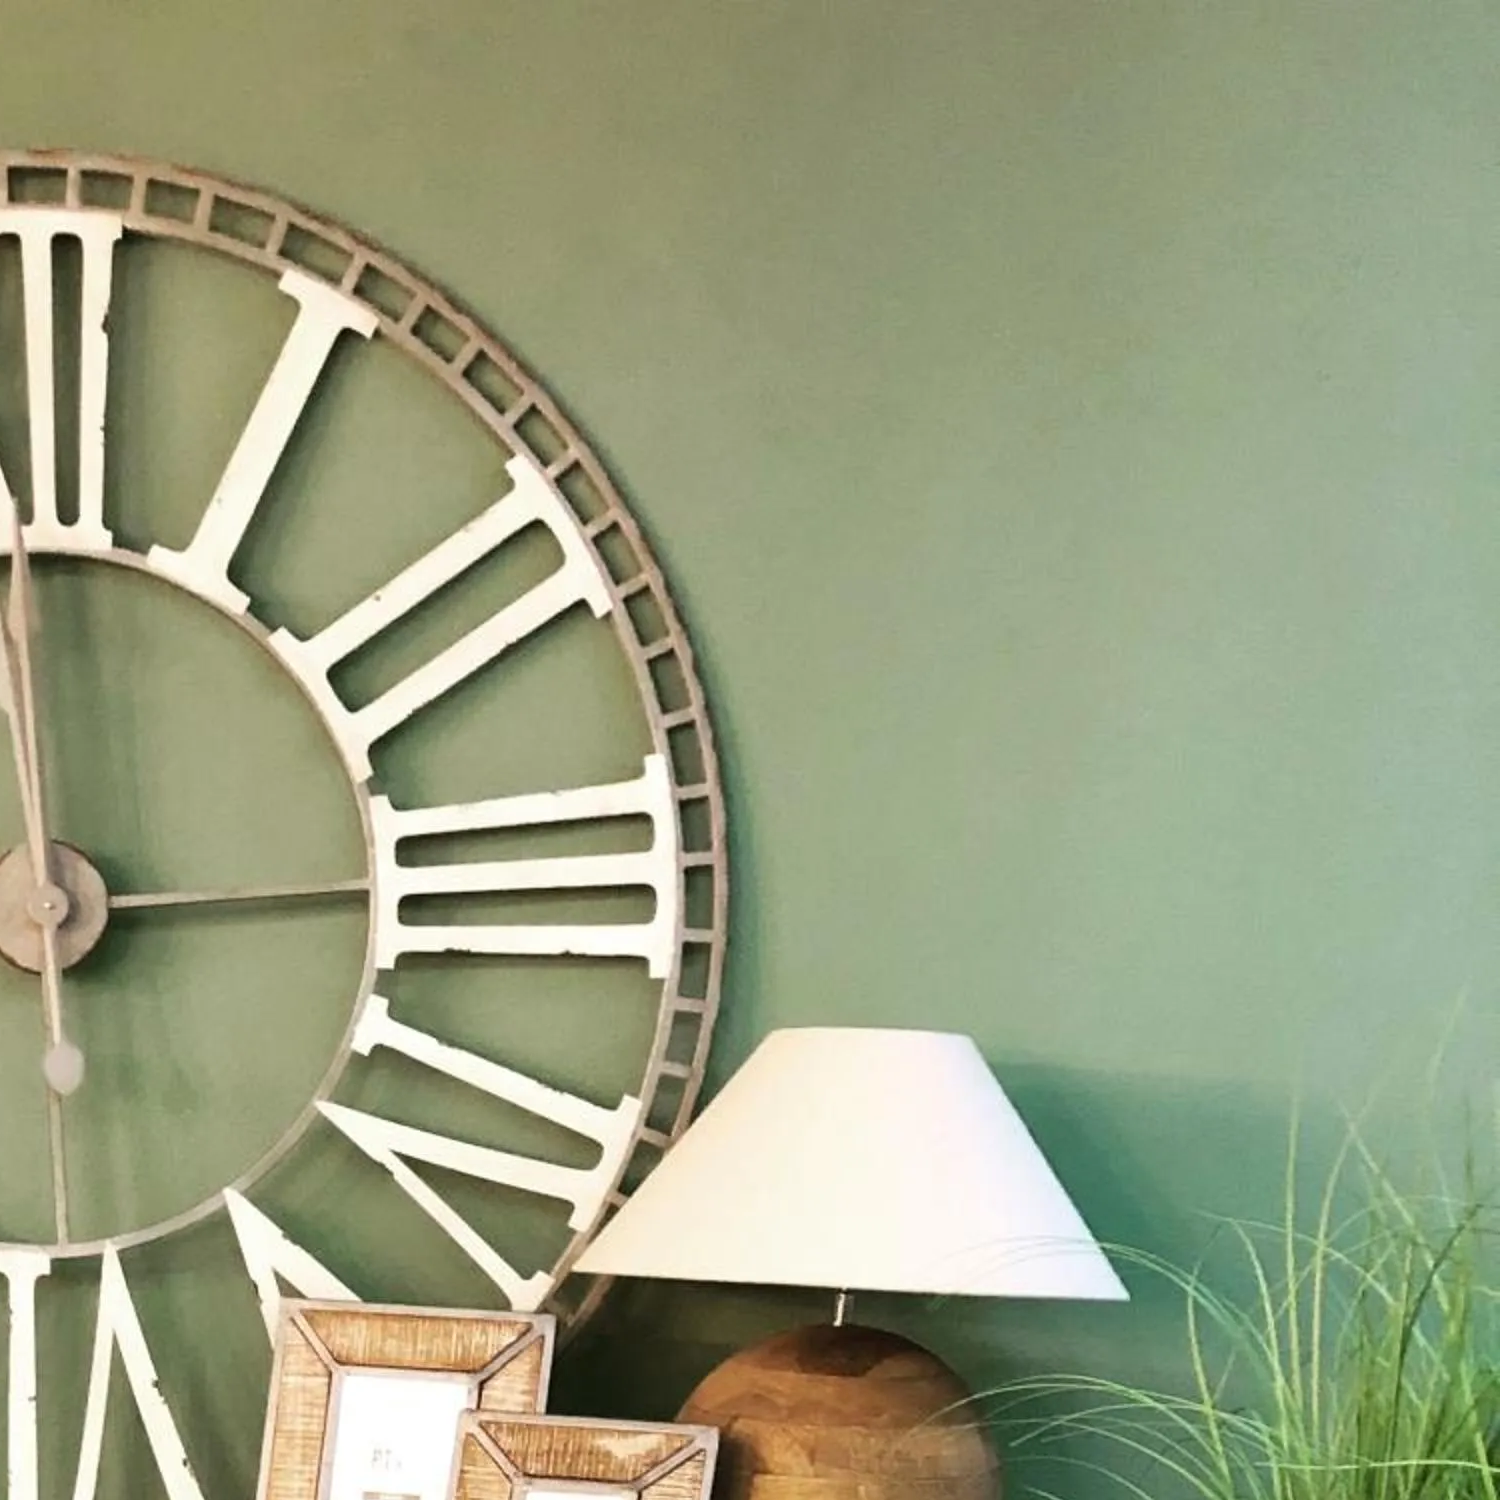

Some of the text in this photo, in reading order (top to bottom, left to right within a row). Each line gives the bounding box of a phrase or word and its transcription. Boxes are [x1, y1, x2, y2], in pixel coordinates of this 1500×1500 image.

[147, 269, 379, 614] I
[268, 454, 613, 781] II
[374, 754, 681, 978] III
[314, 994, 642, 1311] IV
